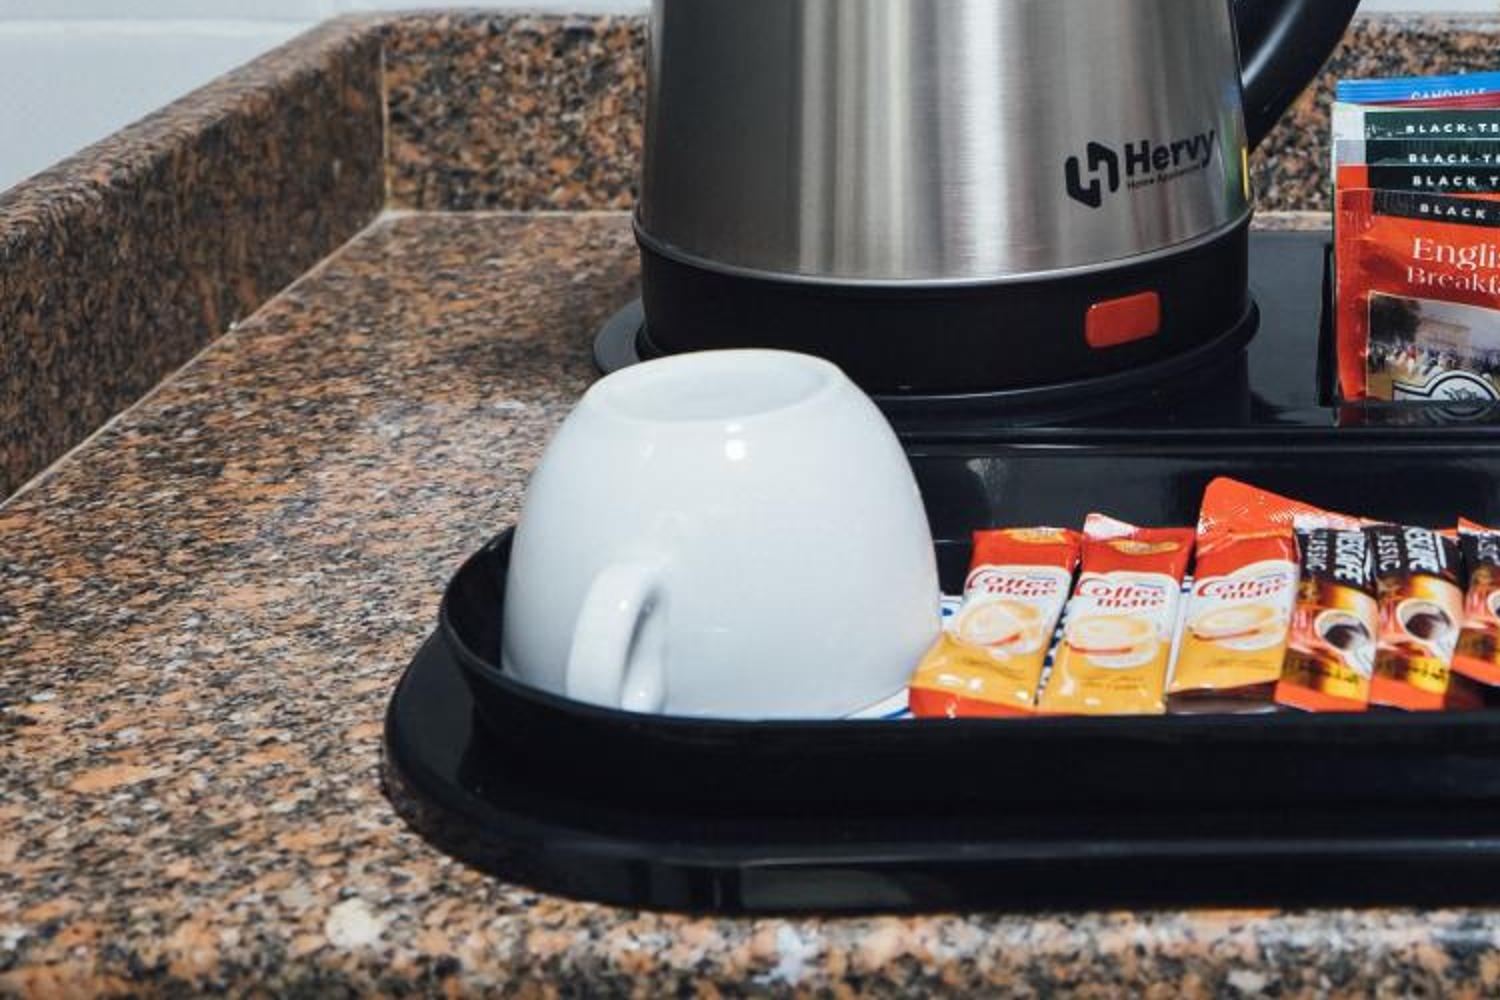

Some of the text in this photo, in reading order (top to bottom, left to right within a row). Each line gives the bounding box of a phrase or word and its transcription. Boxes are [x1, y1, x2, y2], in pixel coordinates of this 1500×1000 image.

[1405, 123, 1467, 134] BLACK
[1124, 129, 1215, 177] Hervy
[1408, 153, 1471, 164] BLACK
[1412, 175, 1477, 187] BLACK
[1420, 203, 1487, 220] BLACK
